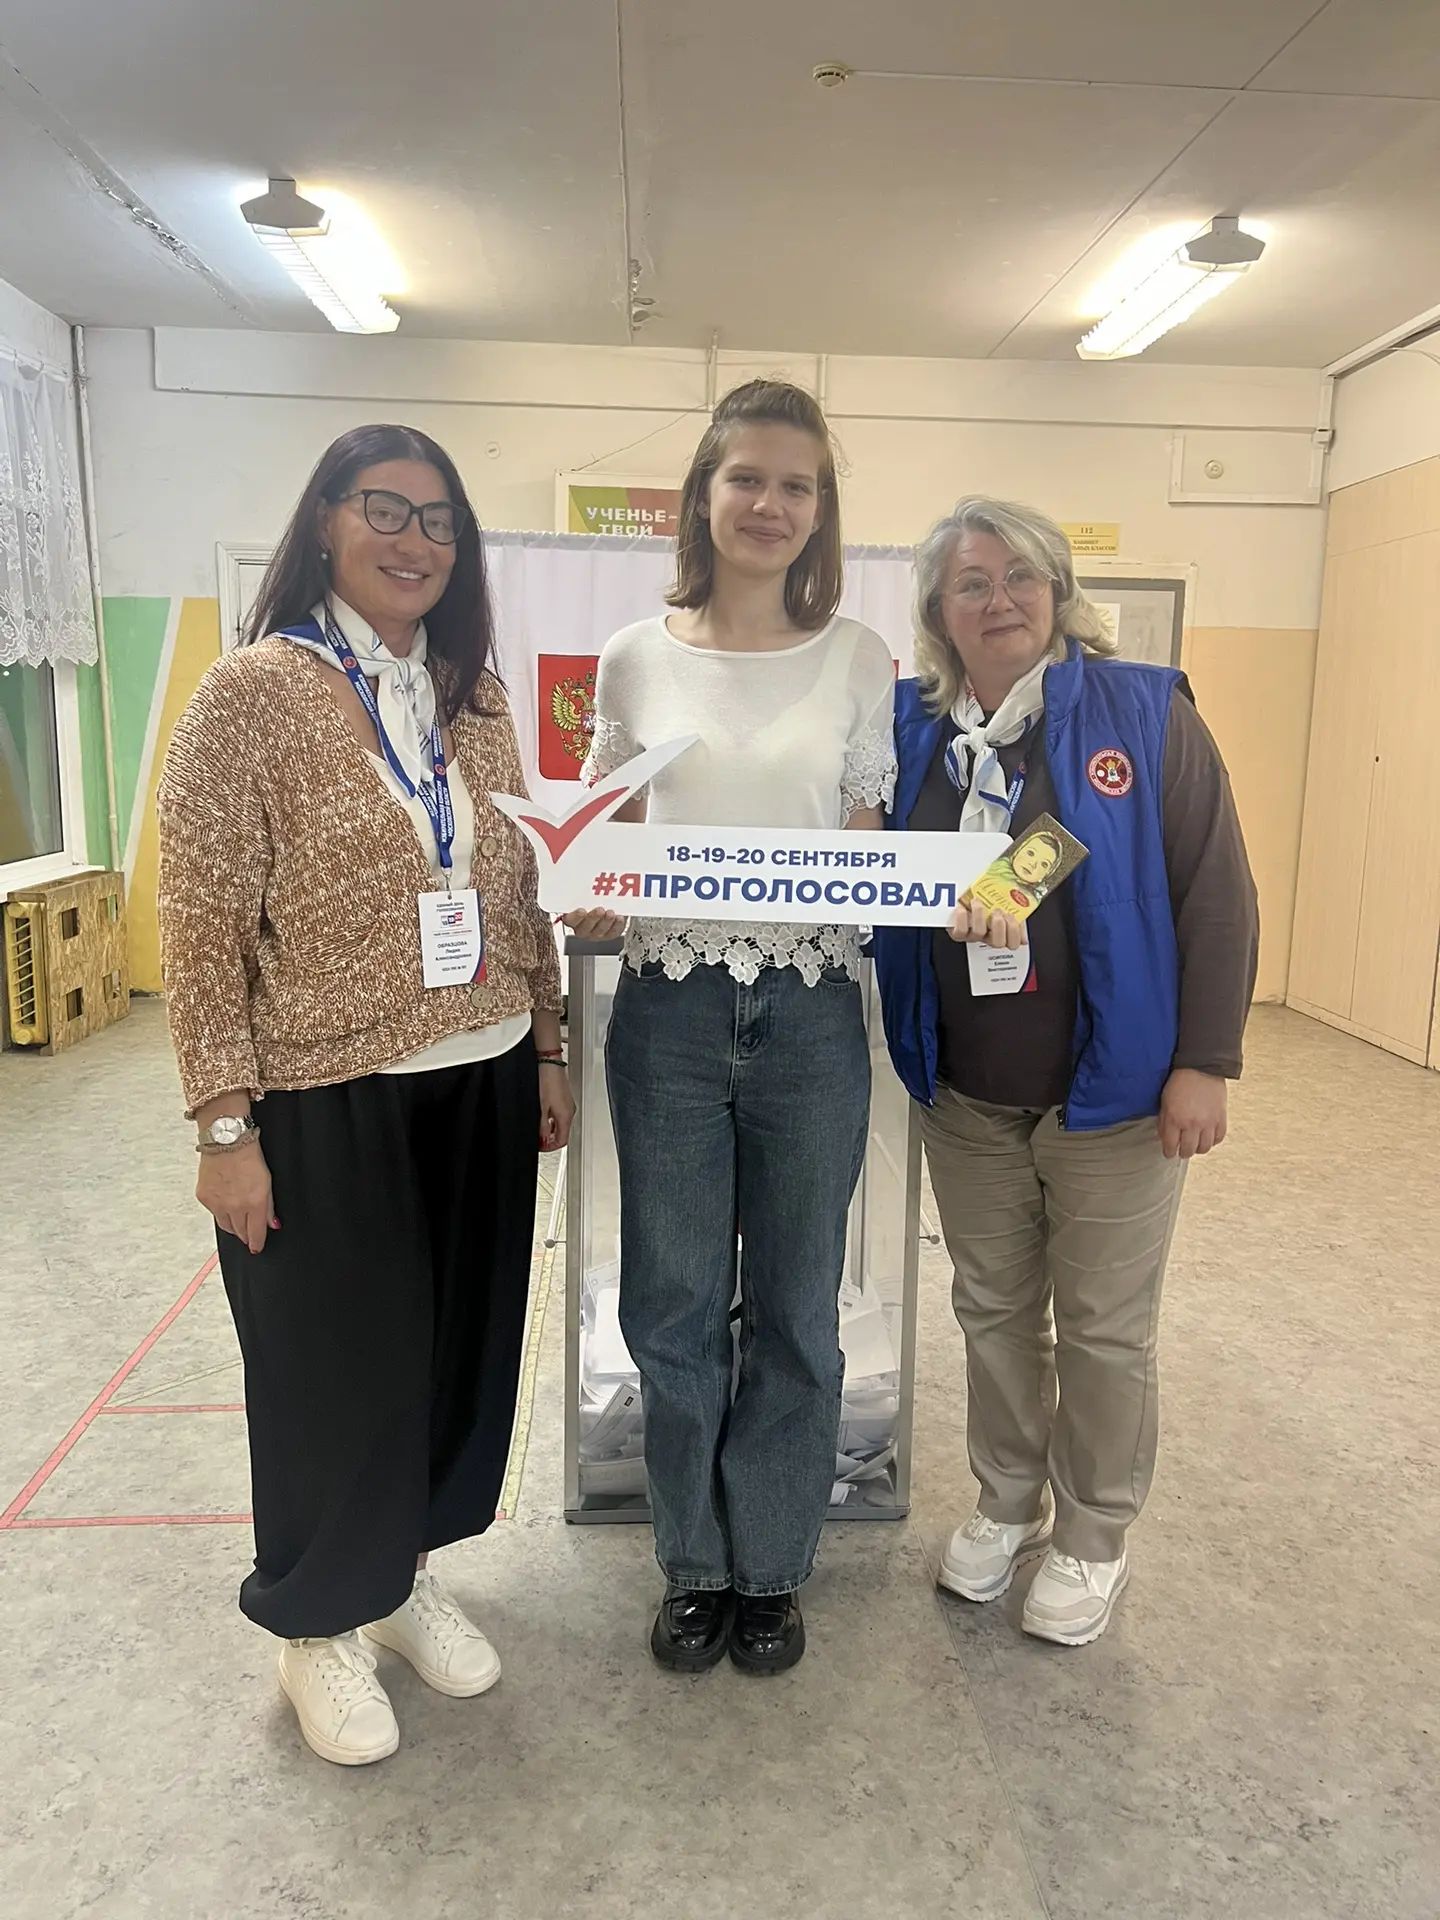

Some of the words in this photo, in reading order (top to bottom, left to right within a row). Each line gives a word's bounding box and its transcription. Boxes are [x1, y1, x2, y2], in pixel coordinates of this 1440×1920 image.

[586, 506, 678, 523] УЧЕНЬЕ-
[598, 523, 654, 536] ТВОЙ
[666, 846, 765, 864] 18-19-20
[771, 849, 897, 868] СЕНТЯБРЯ
[592, 872, 956, 908] #ЯПРОГОЛОСОВАЛ
